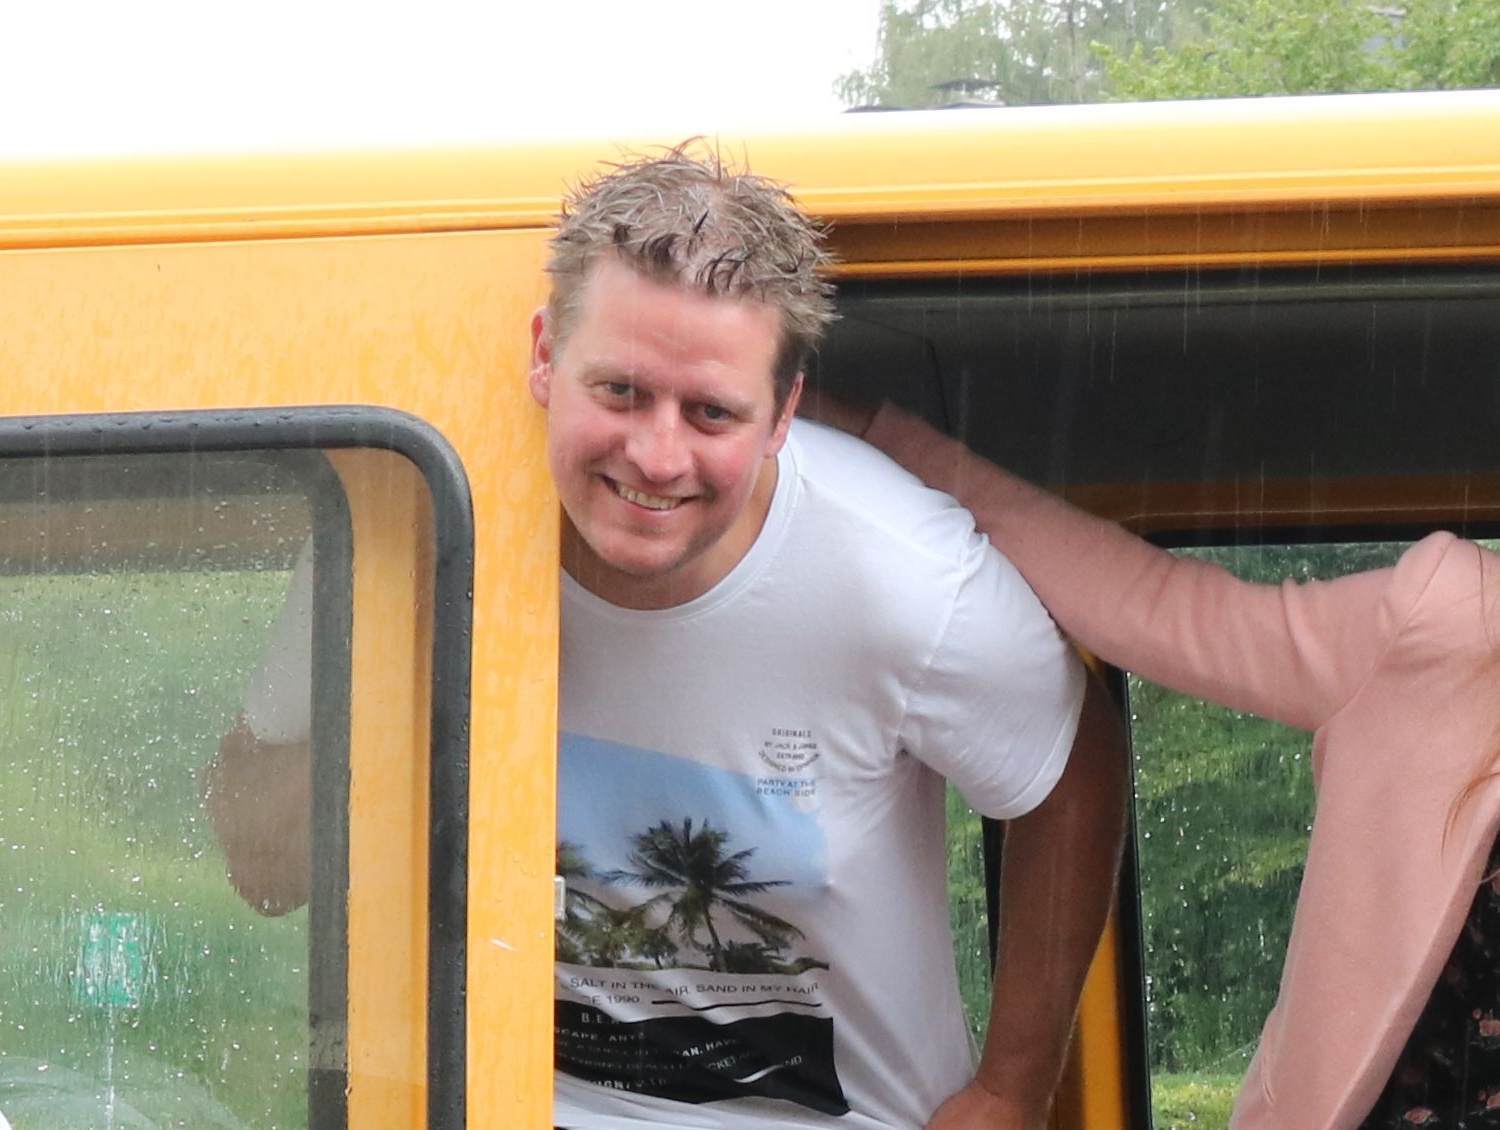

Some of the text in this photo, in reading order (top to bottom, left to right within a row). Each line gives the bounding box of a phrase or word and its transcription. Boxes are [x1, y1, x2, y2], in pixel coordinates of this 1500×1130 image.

[570, 977, 607, 989] SALT
[611, 981, 626, 989] IN
[696, 984, 737, 993] SAND
[742, 985, 756, 993] IN
